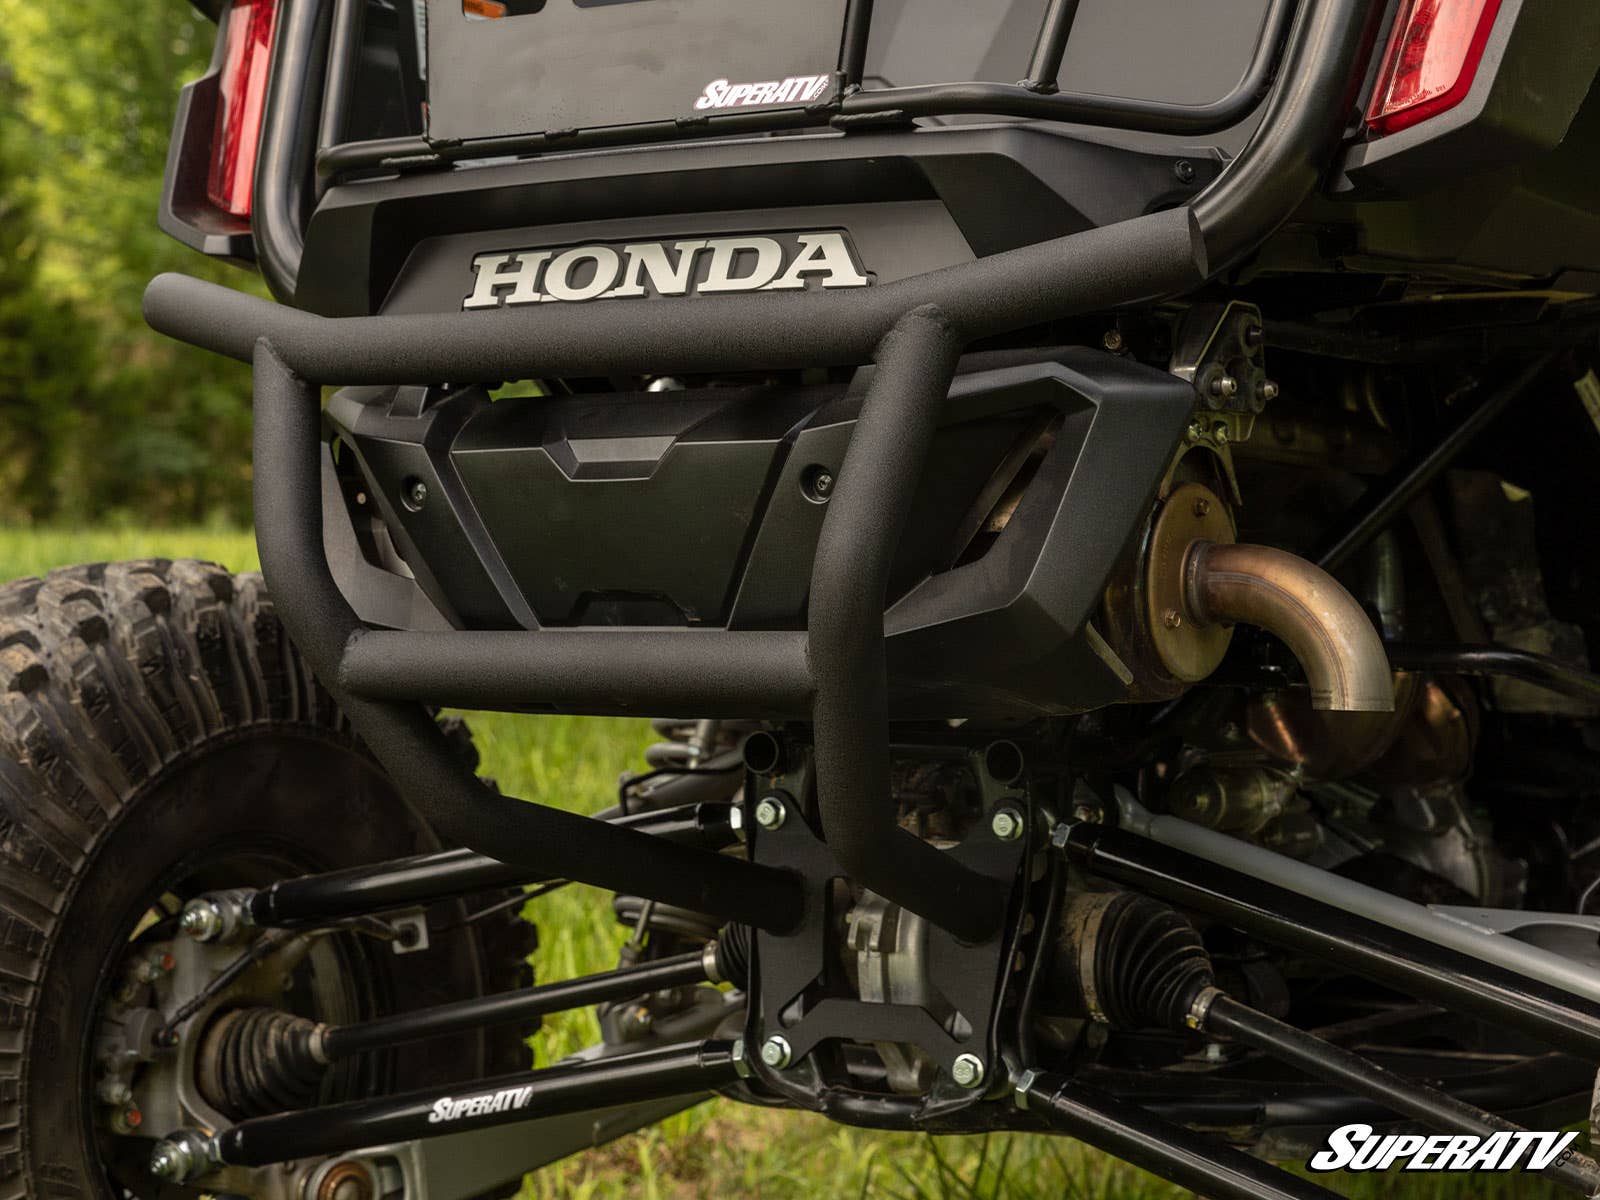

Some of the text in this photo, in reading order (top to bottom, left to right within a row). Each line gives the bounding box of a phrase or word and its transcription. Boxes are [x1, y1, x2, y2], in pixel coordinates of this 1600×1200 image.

[695, 75, 829, 109] SUPERATV
[463, 232, 868, 310] HONDA
[428, 1086, 533, 1123] SUPERATV
